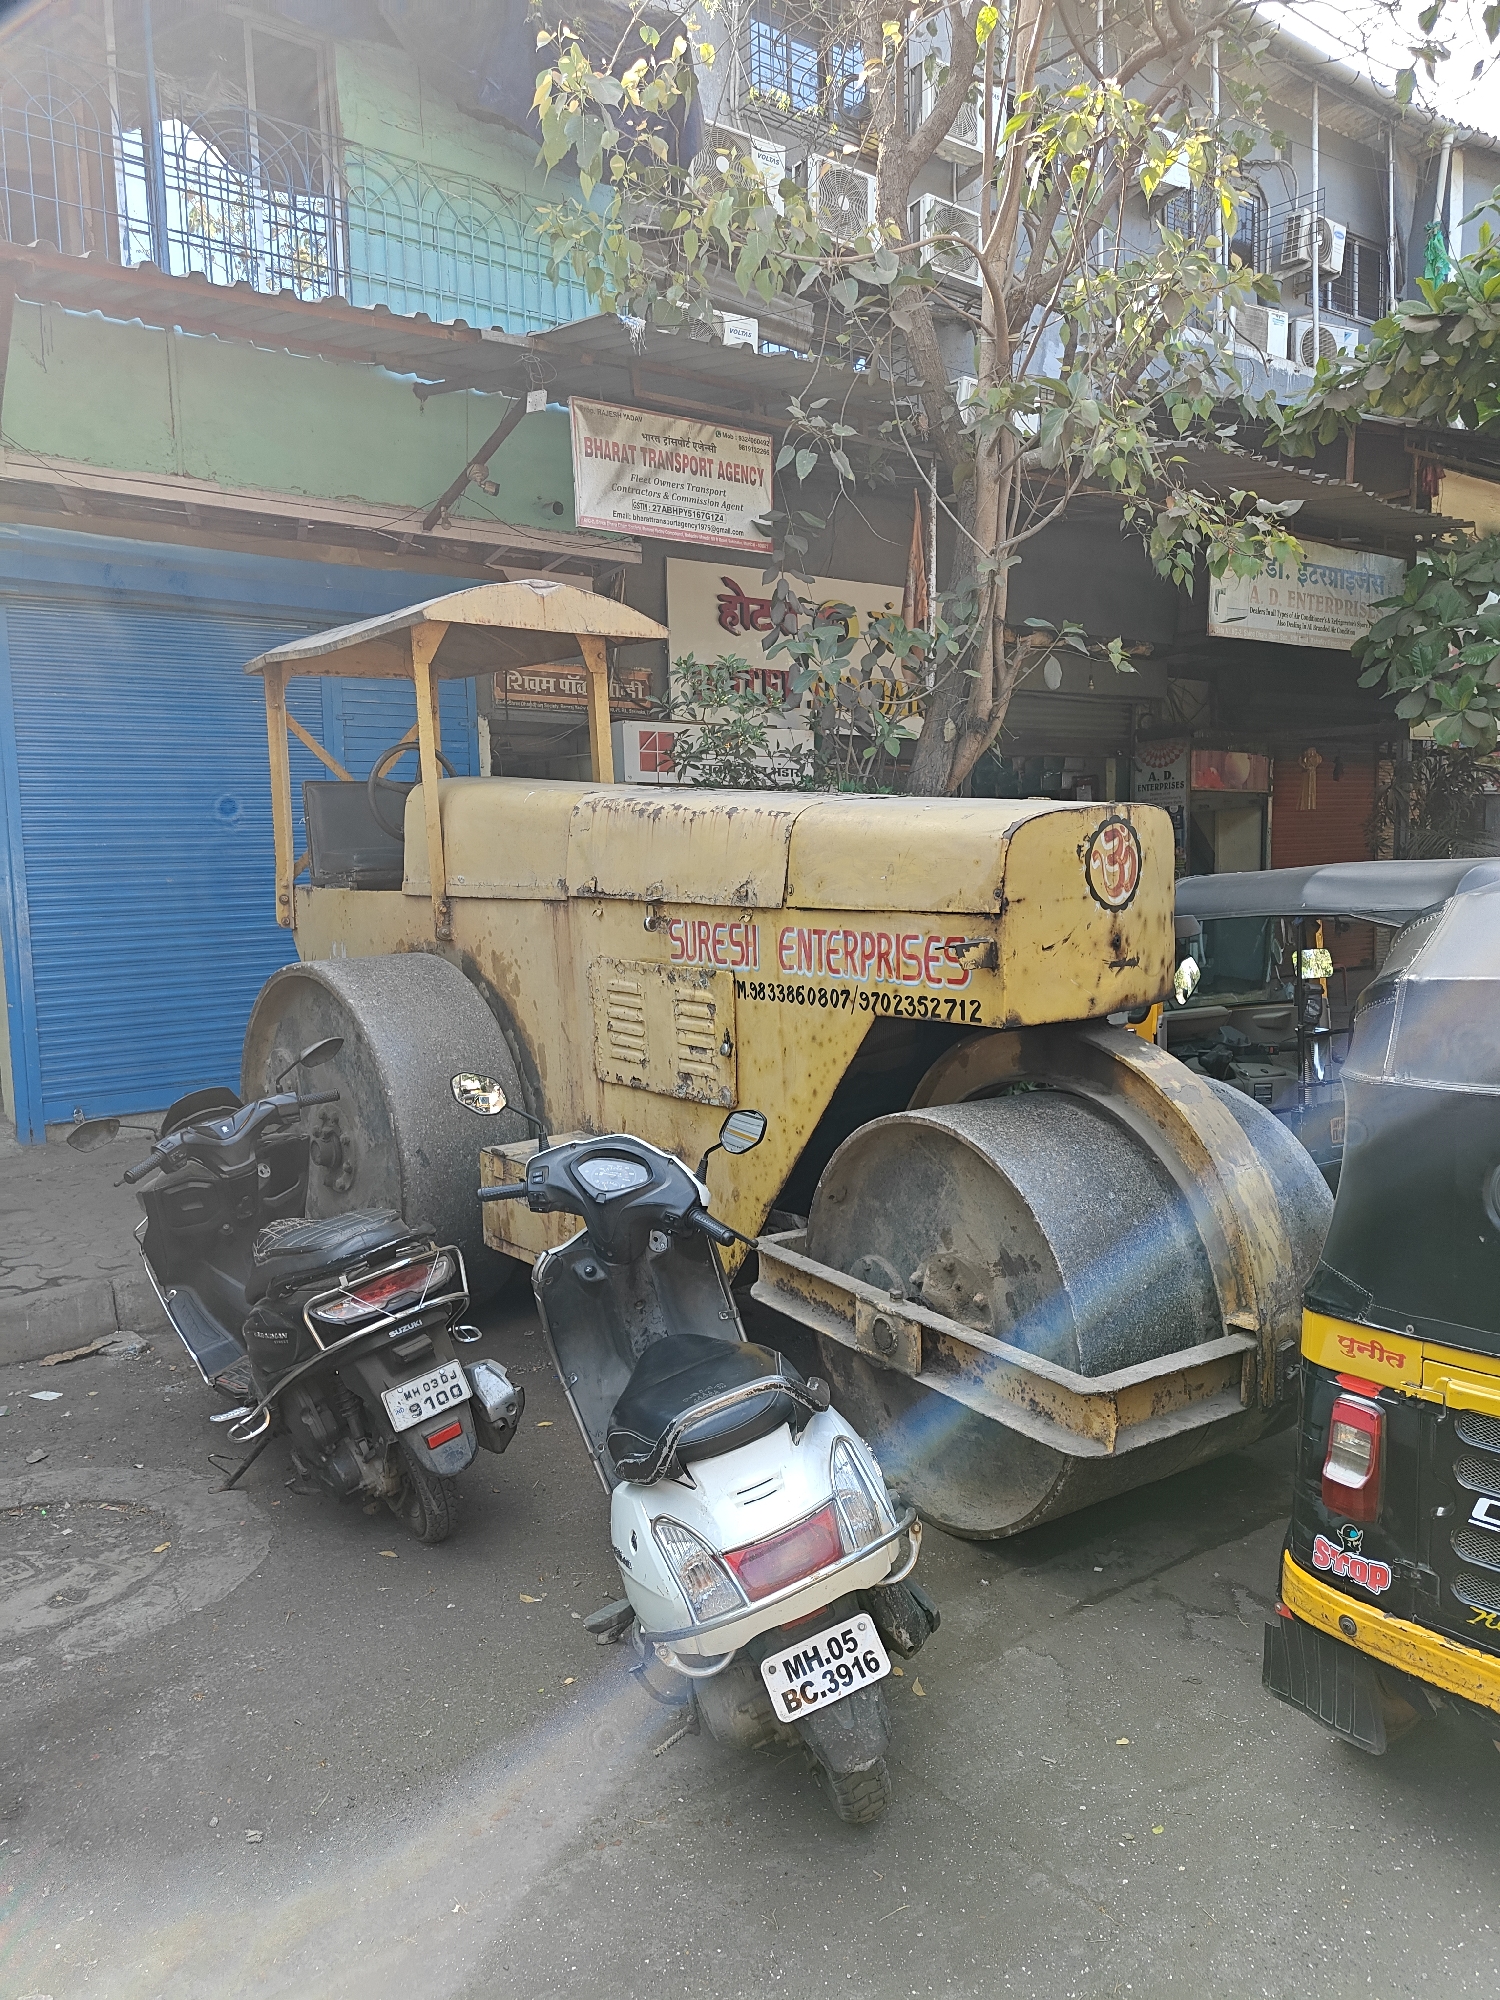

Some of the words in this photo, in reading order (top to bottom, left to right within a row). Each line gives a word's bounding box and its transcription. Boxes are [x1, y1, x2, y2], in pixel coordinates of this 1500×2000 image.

[757, 152, 780, 166] VOLTAS
[729, 327, 752, 338] VOLTAS
[623, 412, 643, 422] YADAV
[641, 433, 661, 444] भारत
[583, 436, 637, 465] BHARAT
[640, 446, 714, 479] TRANSPORT
[717, 461, 765, 487] AGENCY
[611, 482, 662, 498] Contractors
[662, 491, 670, 500] &
[671, 492, 720, 508] Commission
[720, 502, 744, 513] Agent
[630, 473, 652, 484] Fleet
[653, 477, 685, 490] Owners
[686, 482, 727, 498] Transport
[717, 576, 800, 637] होट
[1250, 585, 1264, 605] A.
[1269, 588, 1282, 607] D.
[1137, 780, 1185, 793] ENTERPRISES
[1148, 772, 1160, 782] A.
[1163, 770, 1175, 781] D.
[669, 918, 760, 971] SURESH
[778, 926, 972, 991] ENTERPRISES
[388, 1319, 423, 1338] SUZUKI
[403, 1386, 421, 1401] MH
[422, 1378, 439, 1393] 03
[409, 1383, 463, 1419] 9100
[1312, 1535, 1392, 1595] STOP
[781, 1628, 858, 1684] MH.05
[780, 1649, 880, 1715] BC.3916
